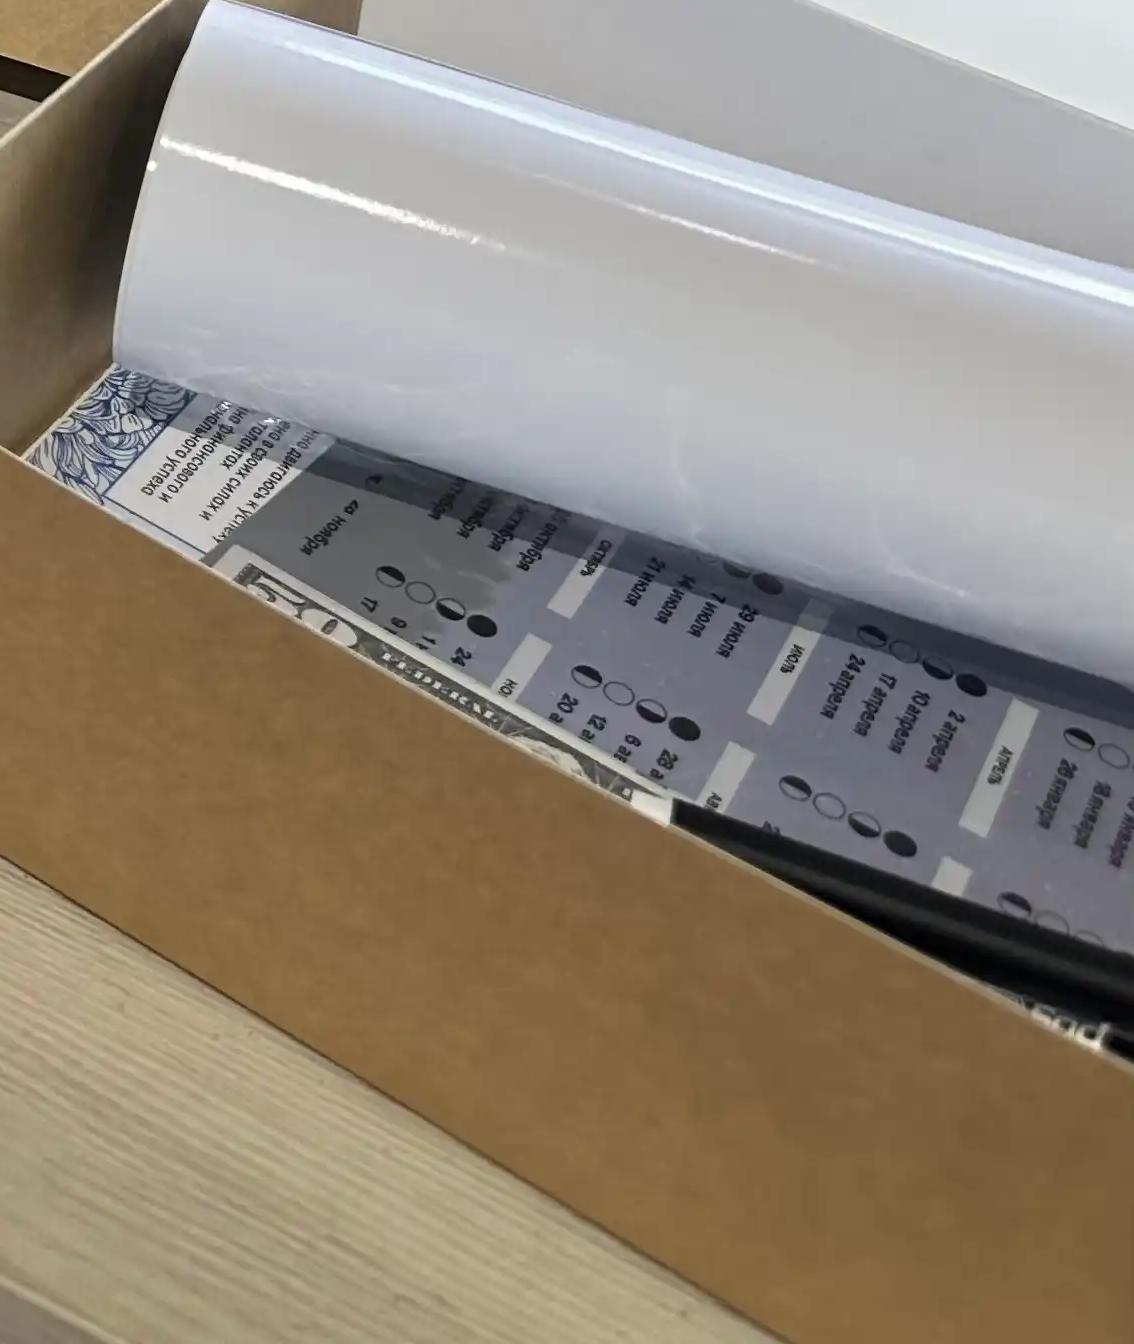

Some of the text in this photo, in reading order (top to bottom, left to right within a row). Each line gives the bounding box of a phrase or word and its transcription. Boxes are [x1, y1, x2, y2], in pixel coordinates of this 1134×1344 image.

[158, 421, 236, 504] финансового и
[219, 421, 268, 471] талантах
[234, 445, 268, 479] своих
[140, 454, 180, 496] успеха
[206, 475, 241, 512] силах
[251, 446, 303, 501] двигаюсь
[198, 509, 213, 521] и
[299, 515, 347, 557] ноября
[515, 520, 558, 573] октября
[358, 594, 379, 614] 17
[626, 568, 662, 608] июля
[654, 586, 684, 625] июля
[687, 590, 726, 639] 7 июля
[449, 644, 473, 669] 24
[715, 620, 746, 659] июля
[780, 643, 805, 675] ИЮЛЬ
[555, 692, 579, 716] 20
[820, 652, 866, 719] 24 апреля
[853, 671, 897, 738] 17 апреля
[586, 711, 609, 732] 12
[623, 732, 643, 749] 6
[887, 688, 931, 754] 10 апреля
[655, 747, 680, 772] 28
[925, 721, 959, 774] апреля
[986, 745, 1014, 786] АПРЕЛЬ
[1036, 775, 1068, 830] января
[1072, 793, 1104, 849] января
